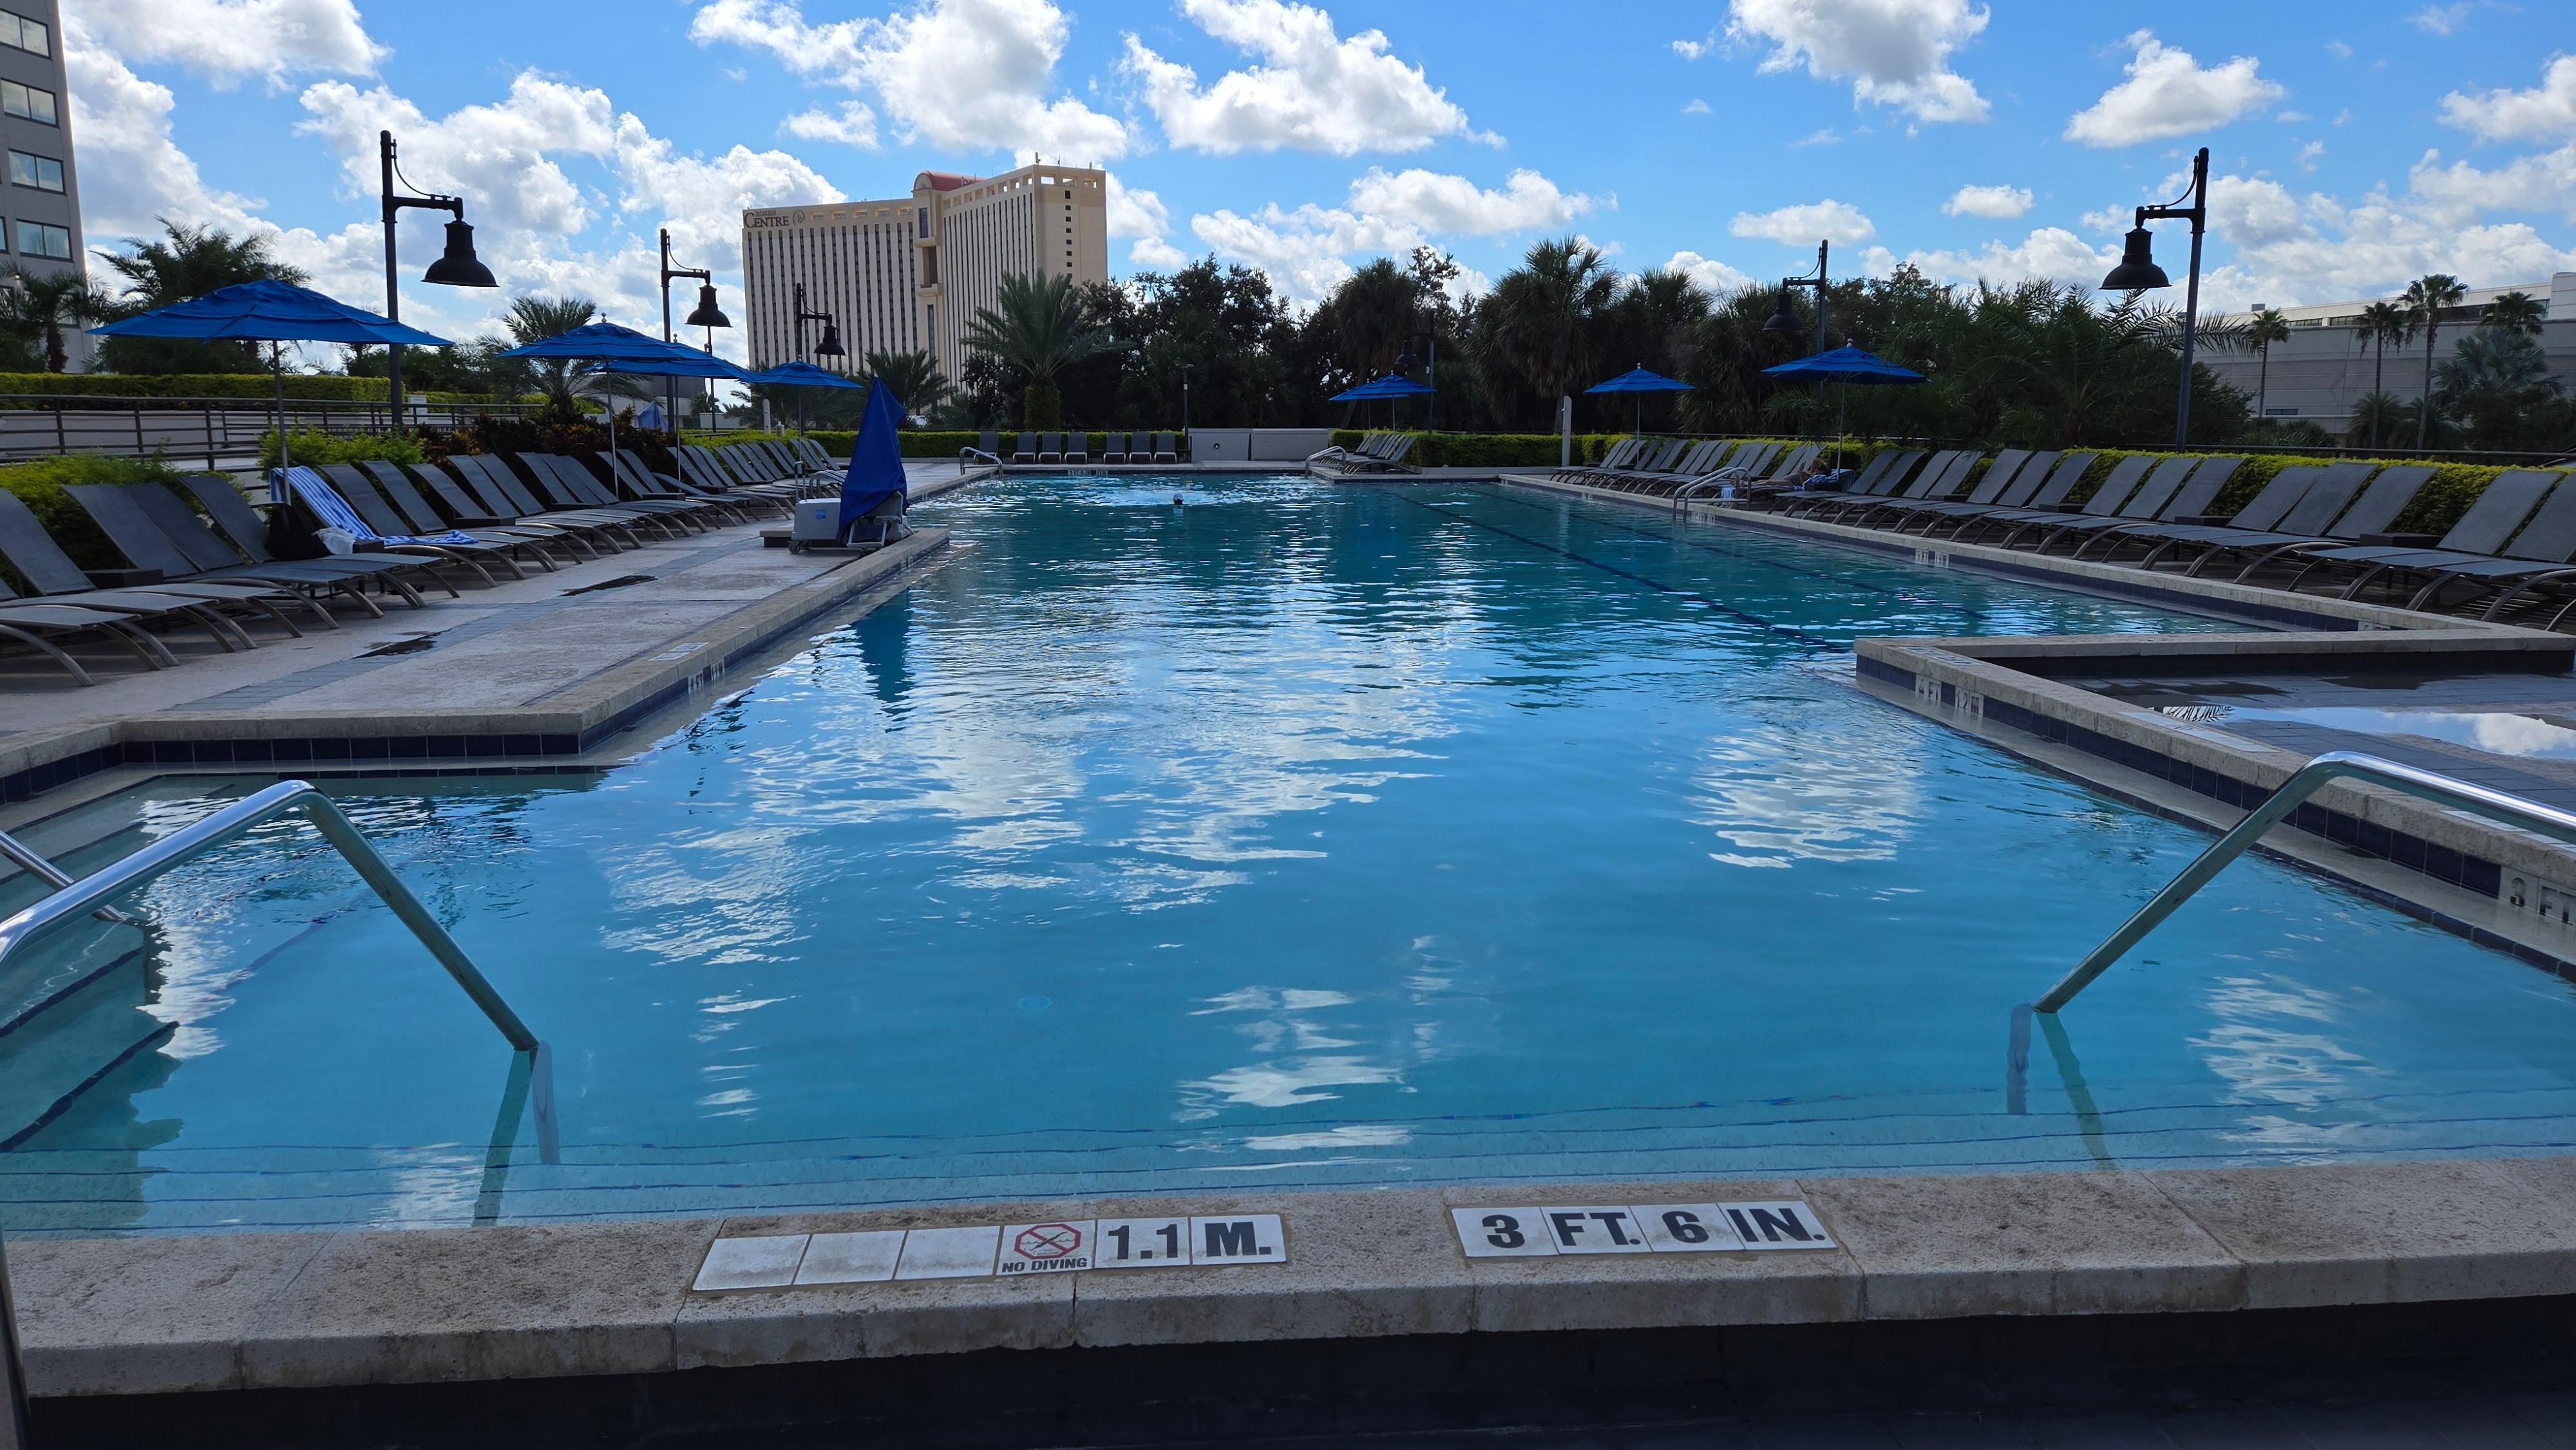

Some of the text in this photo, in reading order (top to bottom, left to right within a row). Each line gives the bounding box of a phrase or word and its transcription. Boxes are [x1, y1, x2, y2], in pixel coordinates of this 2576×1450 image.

[744, 212, 790, 228] CENTRE
[1108, 1221, 1273, 1260] 1.1 M.
[1482, 1207, 1826, 1248] 3 FT. 6 IN.
[1001, 1257, 1088, 1273] NO DIVING
